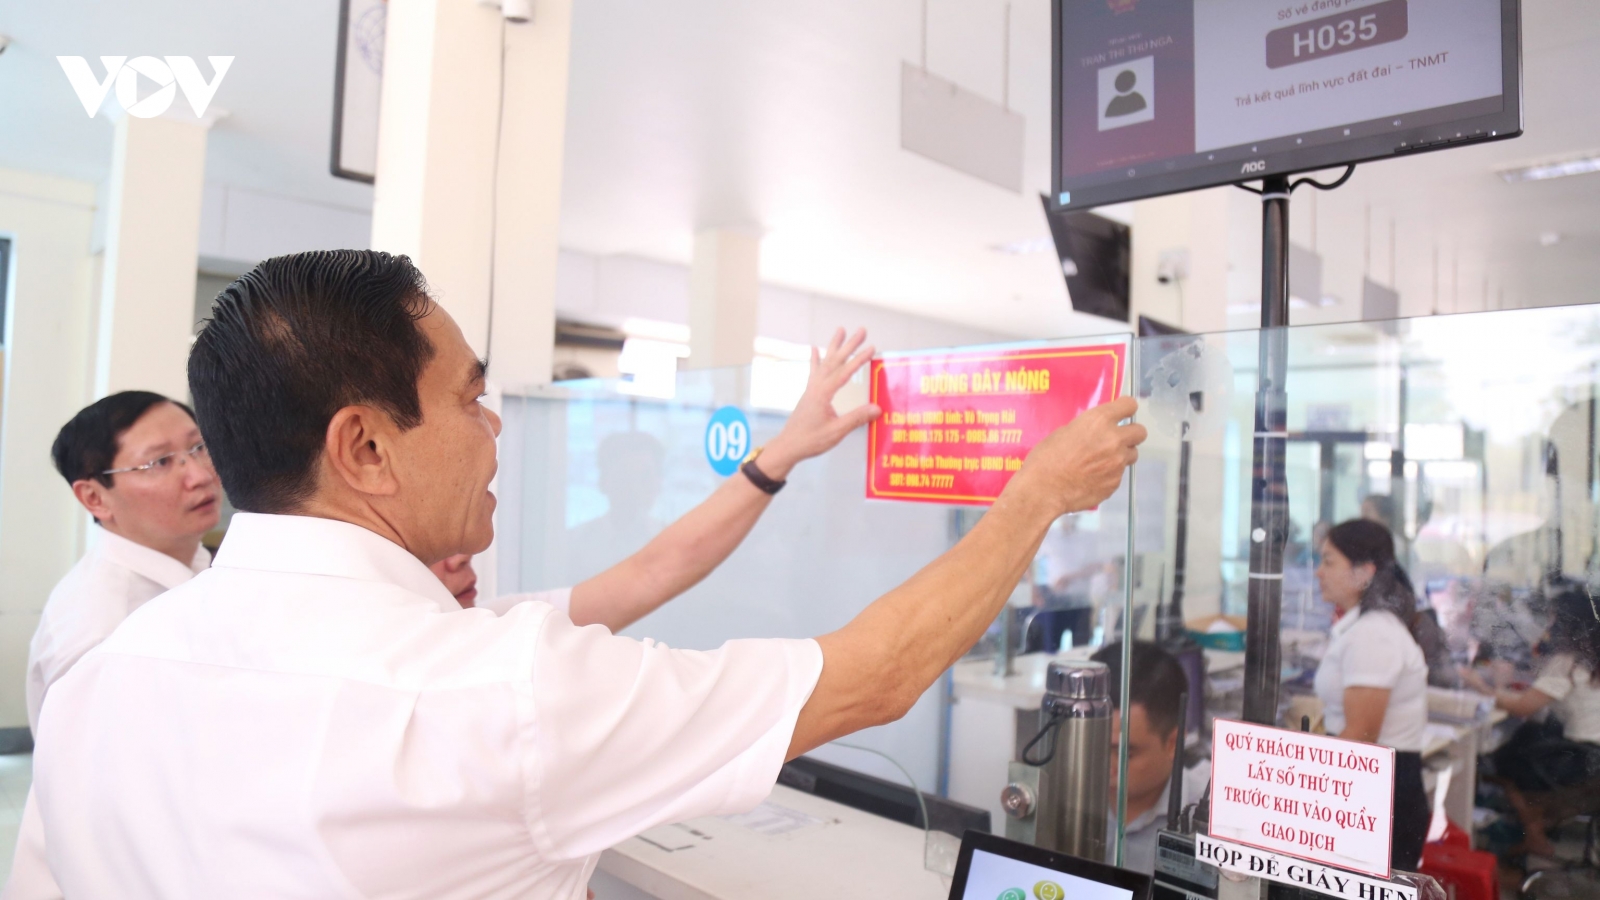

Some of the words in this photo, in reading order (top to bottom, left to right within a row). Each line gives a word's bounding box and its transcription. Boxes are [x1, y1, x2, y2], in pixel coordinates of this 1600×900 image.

[1277, 6, 1292, 21] Số
[1293, 13, 1378, 57] H035
[1235, 94, 1251, 107] Trả
[1254, 89, 1271, 104] kết
[1274, 84, 1295, 101] quả
[1299, 80, 1320, 94] lĩnh
[1322, 76, 1345, 89] vực
[1347, 69, 1368, 84] đất
[1372, 64, 1391, 79] đai
[1408, 51, 1449, 70] TNMT
[1241, 160, 1266, 174] AOC
[920, 370, 968, 395] ĐƯỜNG
[972, 367, 1001, 393] DÂY
[1006, 366, 1050, 391] NÓNG
[883, 411, 892, 425] 1.
[922, 410, 944, 425] UBND
[977, 410, 1000, 426] Trọng
[708, 421, 747, 461] 09
[945, 429, 960, 443] 175
[1001, 429, 1022, 443] 7777
[882, 454, 890, 468] 2.
[981, 456, 1004, 471] UBND
[931, 474, 954, 489] 77777
[1225, 732, 1253, 751] QUÝ
[1256, 737, 1304, 761] KHÁCH
[1308, 747, 1333, 766] VUI
[1338, 750, 1380, 775] LÒNG
[1248, 759, 1274, 783] LẤY
[1276, 765, 1295, 787] SỐ
[1298, 773, 1330, 793] THỨ
[1332, 779, 1353, 802] TỰ
[1224, 786, 1270, 809] TRƯỚC
[1273, 796, 1299, 816] KHI
[1302, 800, 1332, 822] VÀO
[1335, 806, 1377, 832] QUẦY
[1261, 821, 1295, 842] GIAO
[1299, 829, 1336, 852] DỊCH
[1199, 841, 1242, 868] HỘP
[1250, 854, 1280, 878] ĐỂ
[1287, 865, 1350, 899] GIẤY
